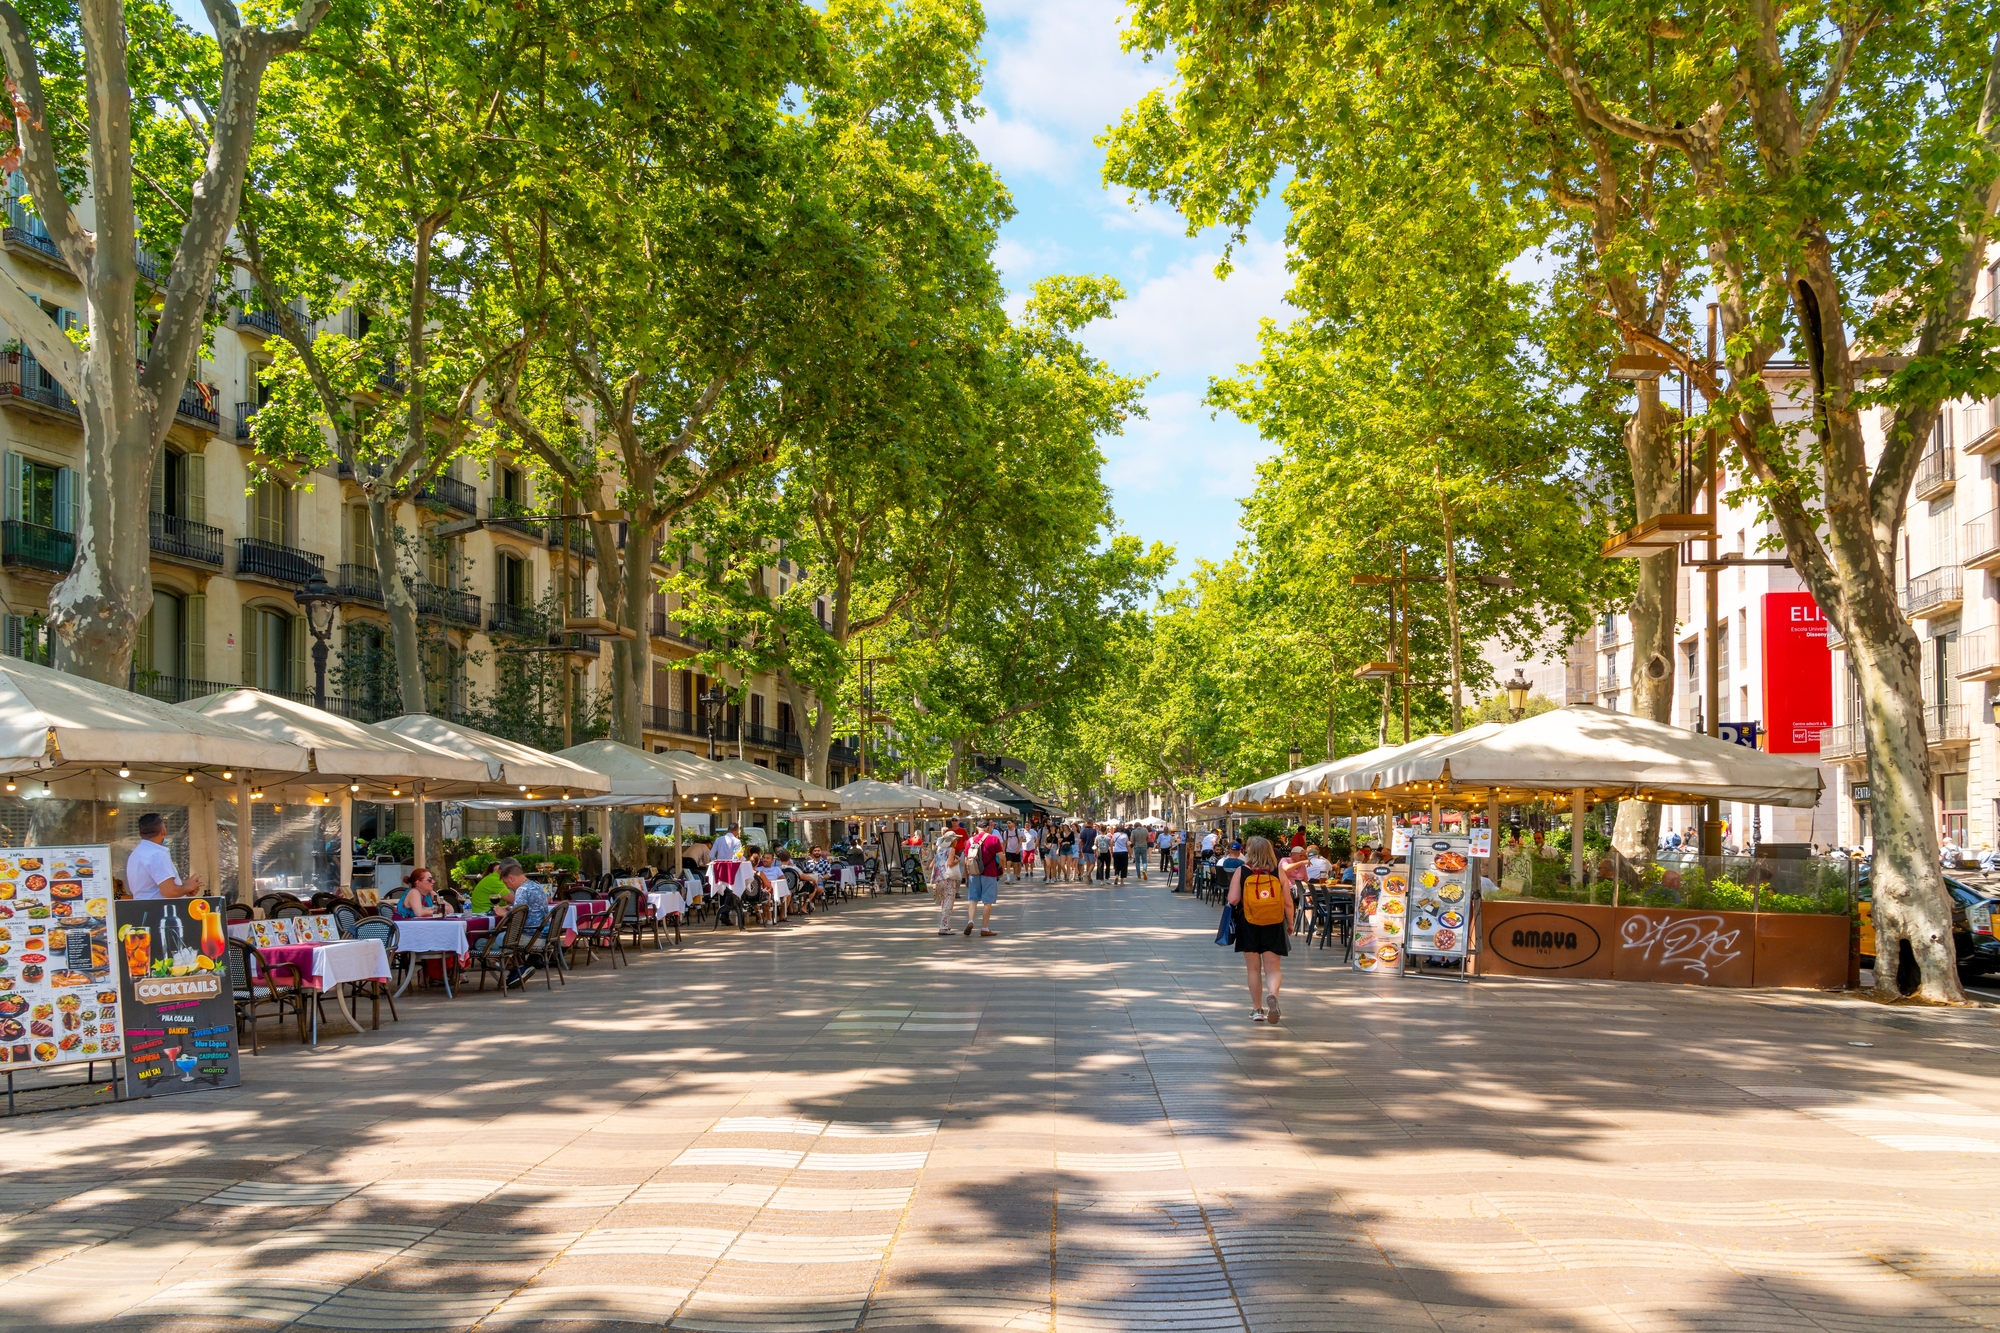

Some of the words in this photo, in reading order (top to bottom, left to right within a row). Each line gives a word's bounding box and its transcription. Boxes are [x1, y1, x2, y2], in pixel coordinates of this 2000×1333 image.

[1511, 930, 1577, 949] AMAYA
[139, 980, 218, 997] COCKTAILS
[174, 1015, 194, 1023] COLADA
[168, 1027, 189, 1035] DAIKIRI
[193, 1028, 212, 1037] APEROL
[138, 1070, 152, 1080] MAI
[151, 1067, 162, 1076] TAI
